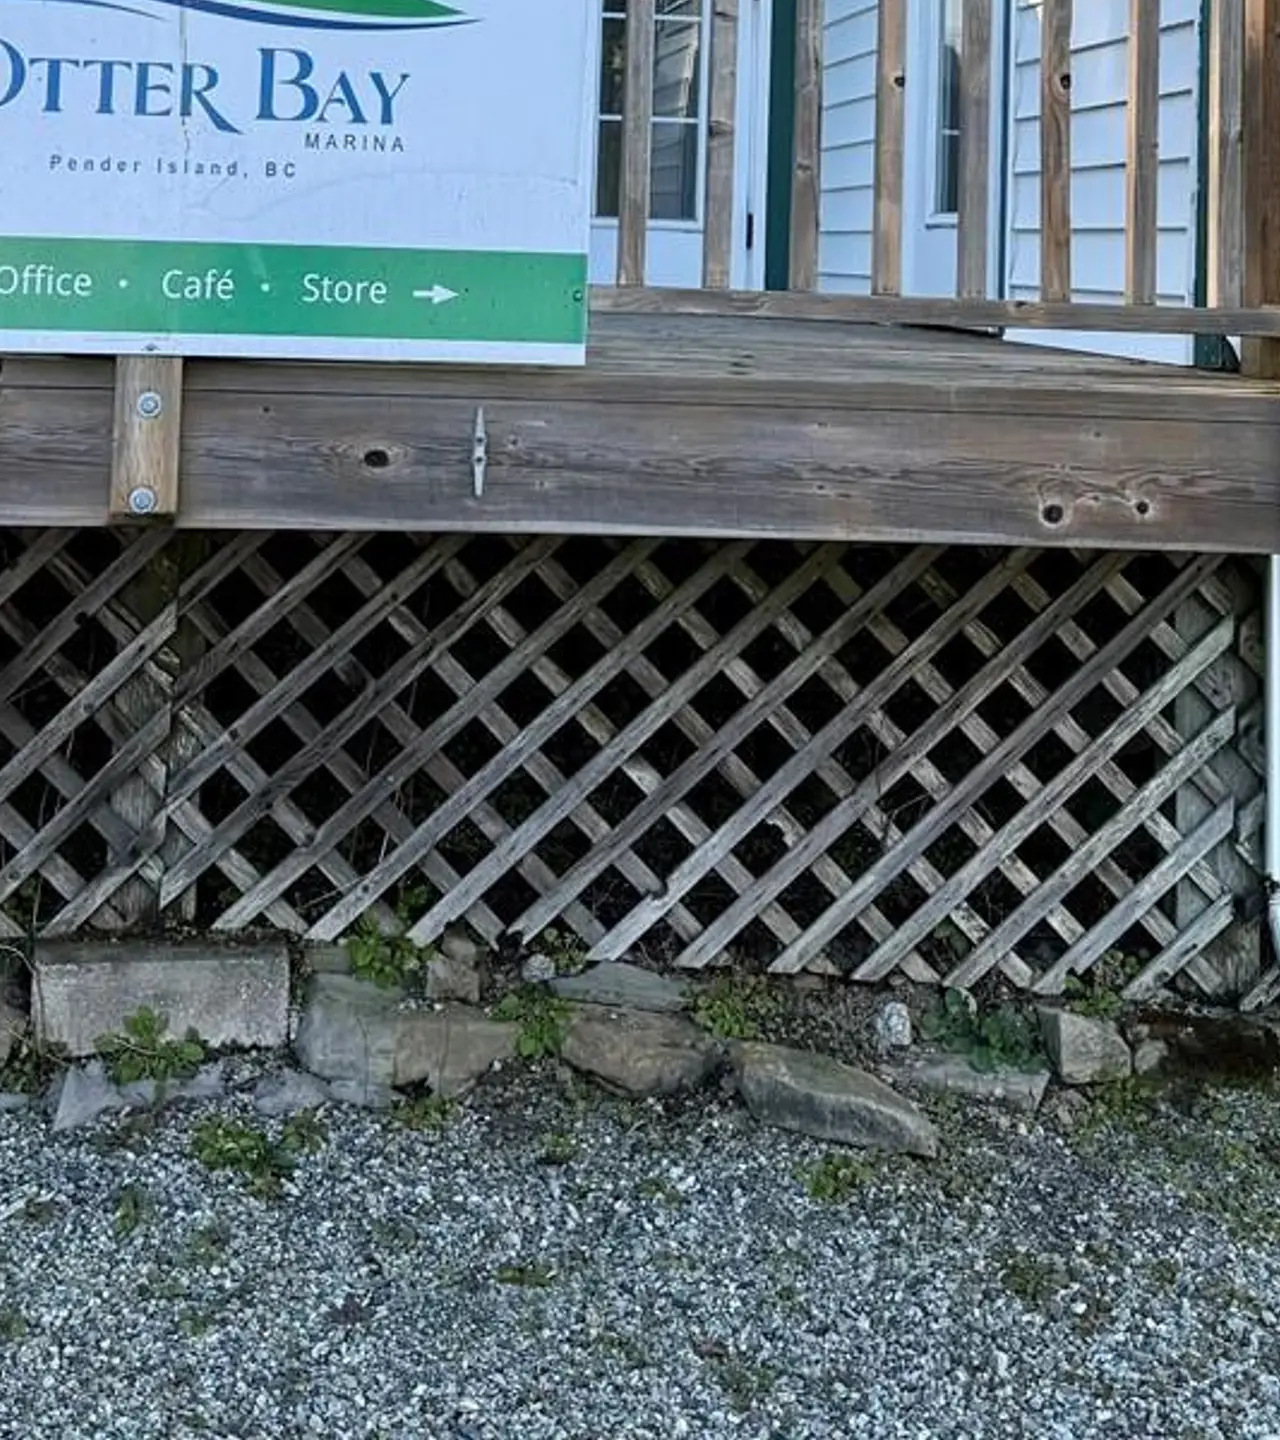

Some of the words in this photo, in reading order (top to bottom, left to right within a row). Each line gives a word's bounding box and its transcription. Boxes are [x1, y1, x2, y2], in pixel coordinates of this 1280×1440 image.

[255, 47, 412, 125] BAY
[304, 132, 406, 153] MARINA
[49, 154, 142, 173] Pender
[156, 158, 249, 179] Island,
[265, 162, 297, 178] BC
[161, 268, 236, 300] Café
[301, 273, 388, 304] Store
